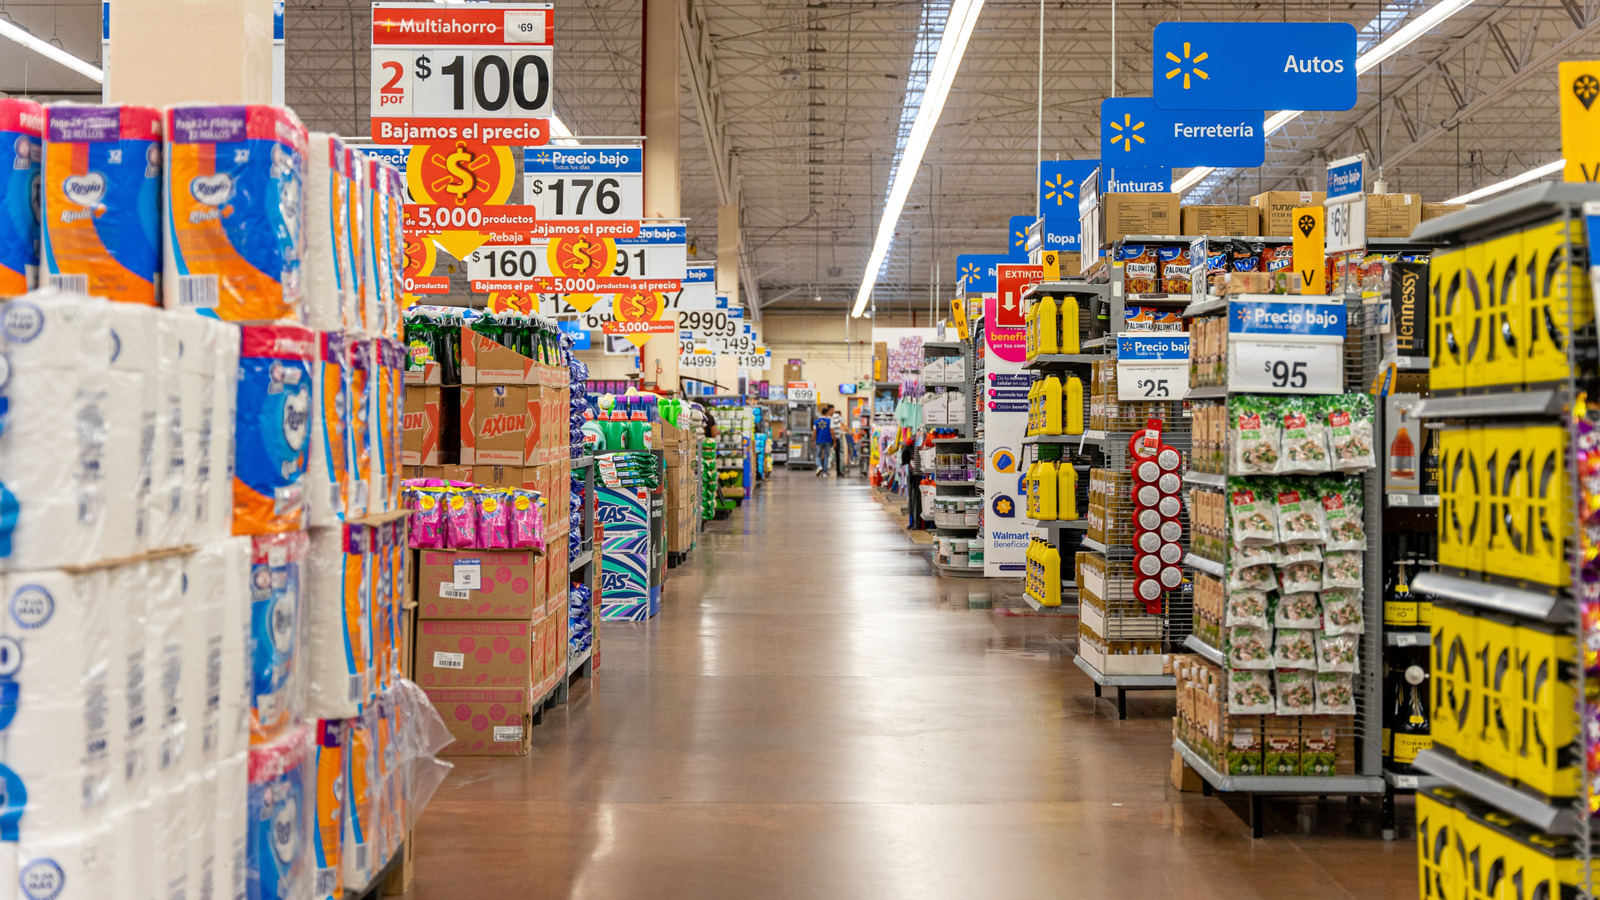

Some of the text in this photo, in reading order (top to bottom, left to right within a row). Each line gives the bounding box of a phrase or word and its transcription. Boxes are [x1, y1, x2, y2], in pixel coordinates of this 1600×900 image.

[400, 18, 497, 33] Multiahorro
[1284, 54, 1344, 74] Autos
[380, 60, 404, 94] 2
[380, 95, 405, 107] por
[50, 118, 68, 130] Paga
[1174, 122, 1254, 138] Ferretería
[73, 129, 104, 139] ROLLOS
[200, 129, 230, 139] ROLLOS
[381, 121, 541, 144] Bajamos el precio
[553, 151, 629, 168] Precio bajo
[1334, 168, 1360, 186] Precio bajo
[70, 182, 101, 195] Regio
[196, 182, 229, 195] Regio
[1107, 180, 1164, 193] Pinturas
[418, 207, 482, 228] 5,000
[482, 214, 534, 226] productos
[583, 223, 594, 234] el
[596, 223, 634, 238] precio
[654, 228, 677, 241] bajo
[490, 232, 523, 245] Rebaja
[1047, 233, 1075, 246] Ropa
[1128, 263, 1156, 273] PALOMITAS
[1207, 253, 1227, 270] POP
[689, 270, 707, 280] bajo
[1301, 269, 1315, 287] V
[475, 281, 513, 292] Bajamos
[514, 281, 522, 291] el
[554, 277, 596, 292] 5,000
[596, 282, 630, 291] productos
[639, 281, 677, 292] el precio
[1397, 268, 1420, 350] Hennessy
[679, 311, 727, 331] 2990
[1254, 308, 1338, 329] Precio bajo
[619, 321, 649, 333] 5,000
[1154, 323, 1182, 332] PALOMITAS
[1134, 341, 1169, 352] Precio
[1264, 360, 1308, 388] $95
[480, 413, 526, 438] AXION
[992, 531, 1029, 540] Walmart
[433, 623, 445, 633] TUS
[474, 624, 488, 633] PARA
[489, 624, 497, 633] EL
[499, 624, 520, 634] HOGAR
[470, 690, 485, 701] PARA
[486, 690, 494, 701] EL
[495, 690, 516, 701] HOGAR
